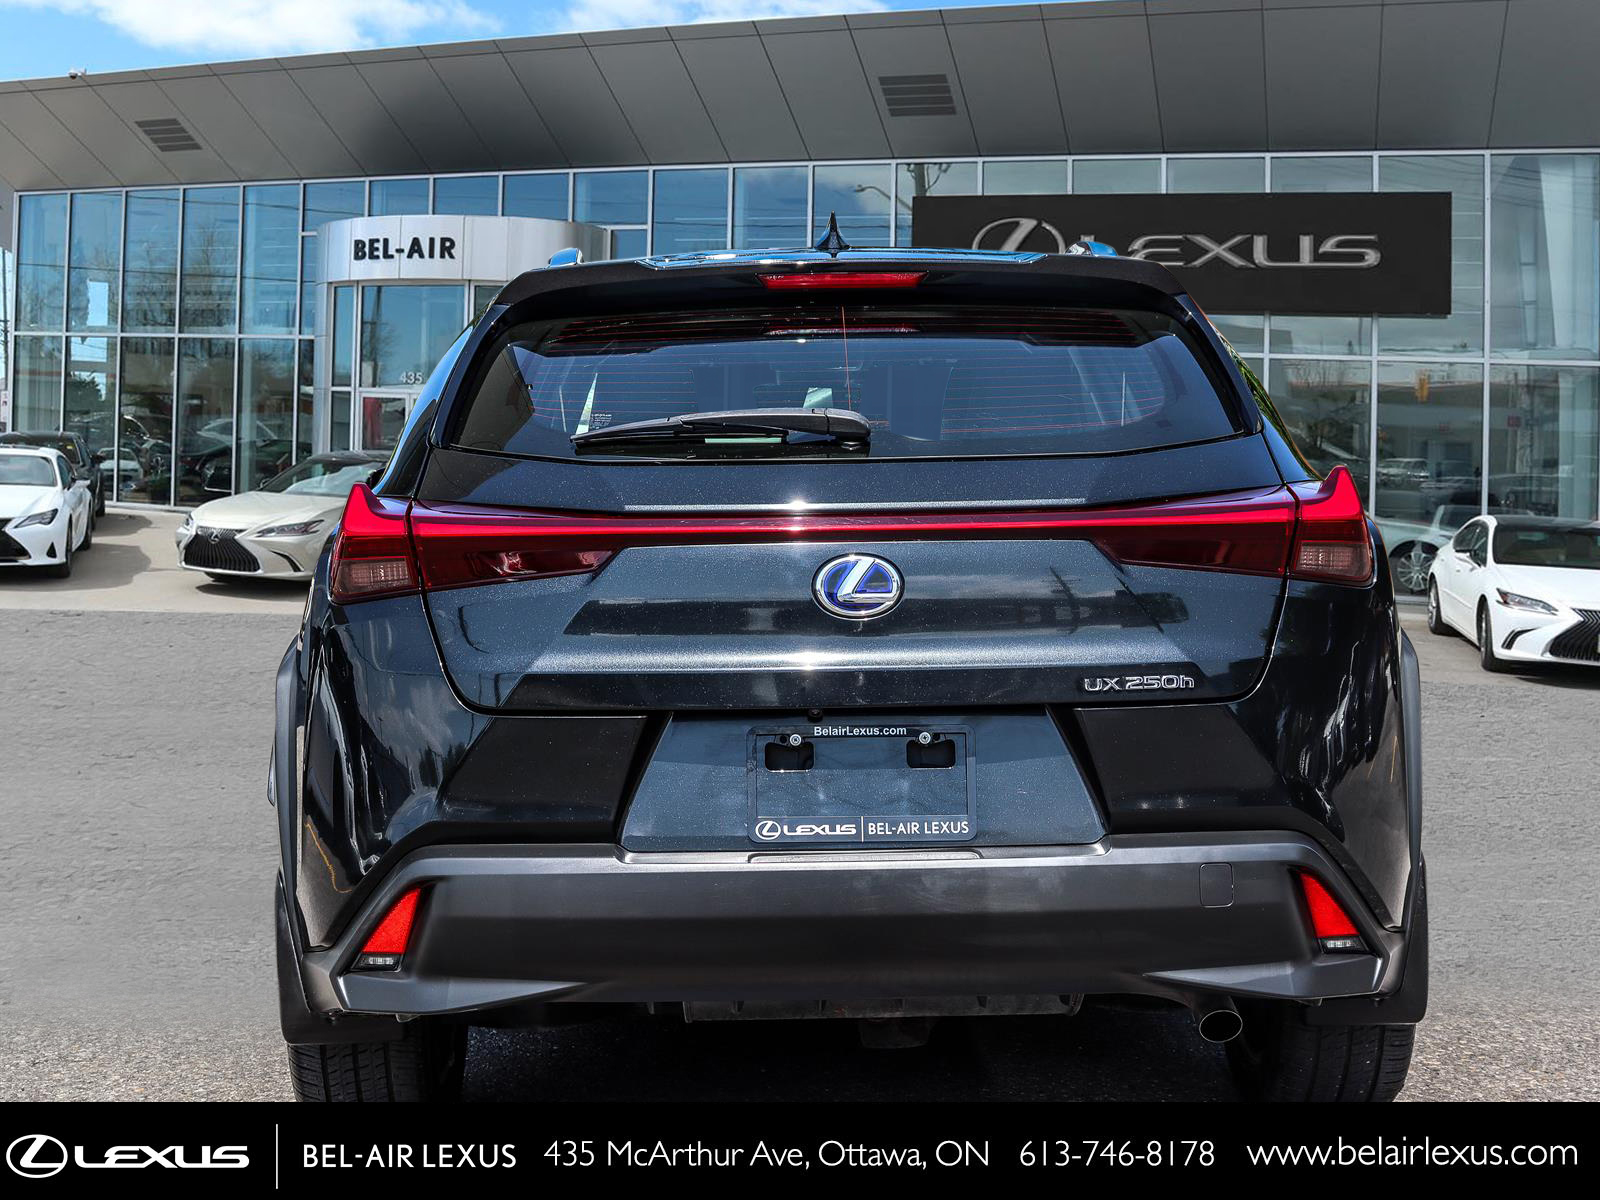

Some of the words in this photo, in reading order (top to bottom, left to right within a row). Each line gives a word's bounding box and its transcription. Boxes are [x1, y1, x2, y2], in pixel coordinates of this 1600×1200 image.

[353, 237, 456, 261] BEL-AIR
[1080, 234, 1381, 268] EXUS
[399, 371, 424, 386] 435
[1083, 677, 1121, 692] UX
[1125, 674, 1196, 690] 250h
[813, 726, 908, 737] BelairLexus.com
[782, 823, 857, 836] LEXUS
[868, 822, 920, 835] BEL-AIR
[924, 820, 970, 834] LEXUS
